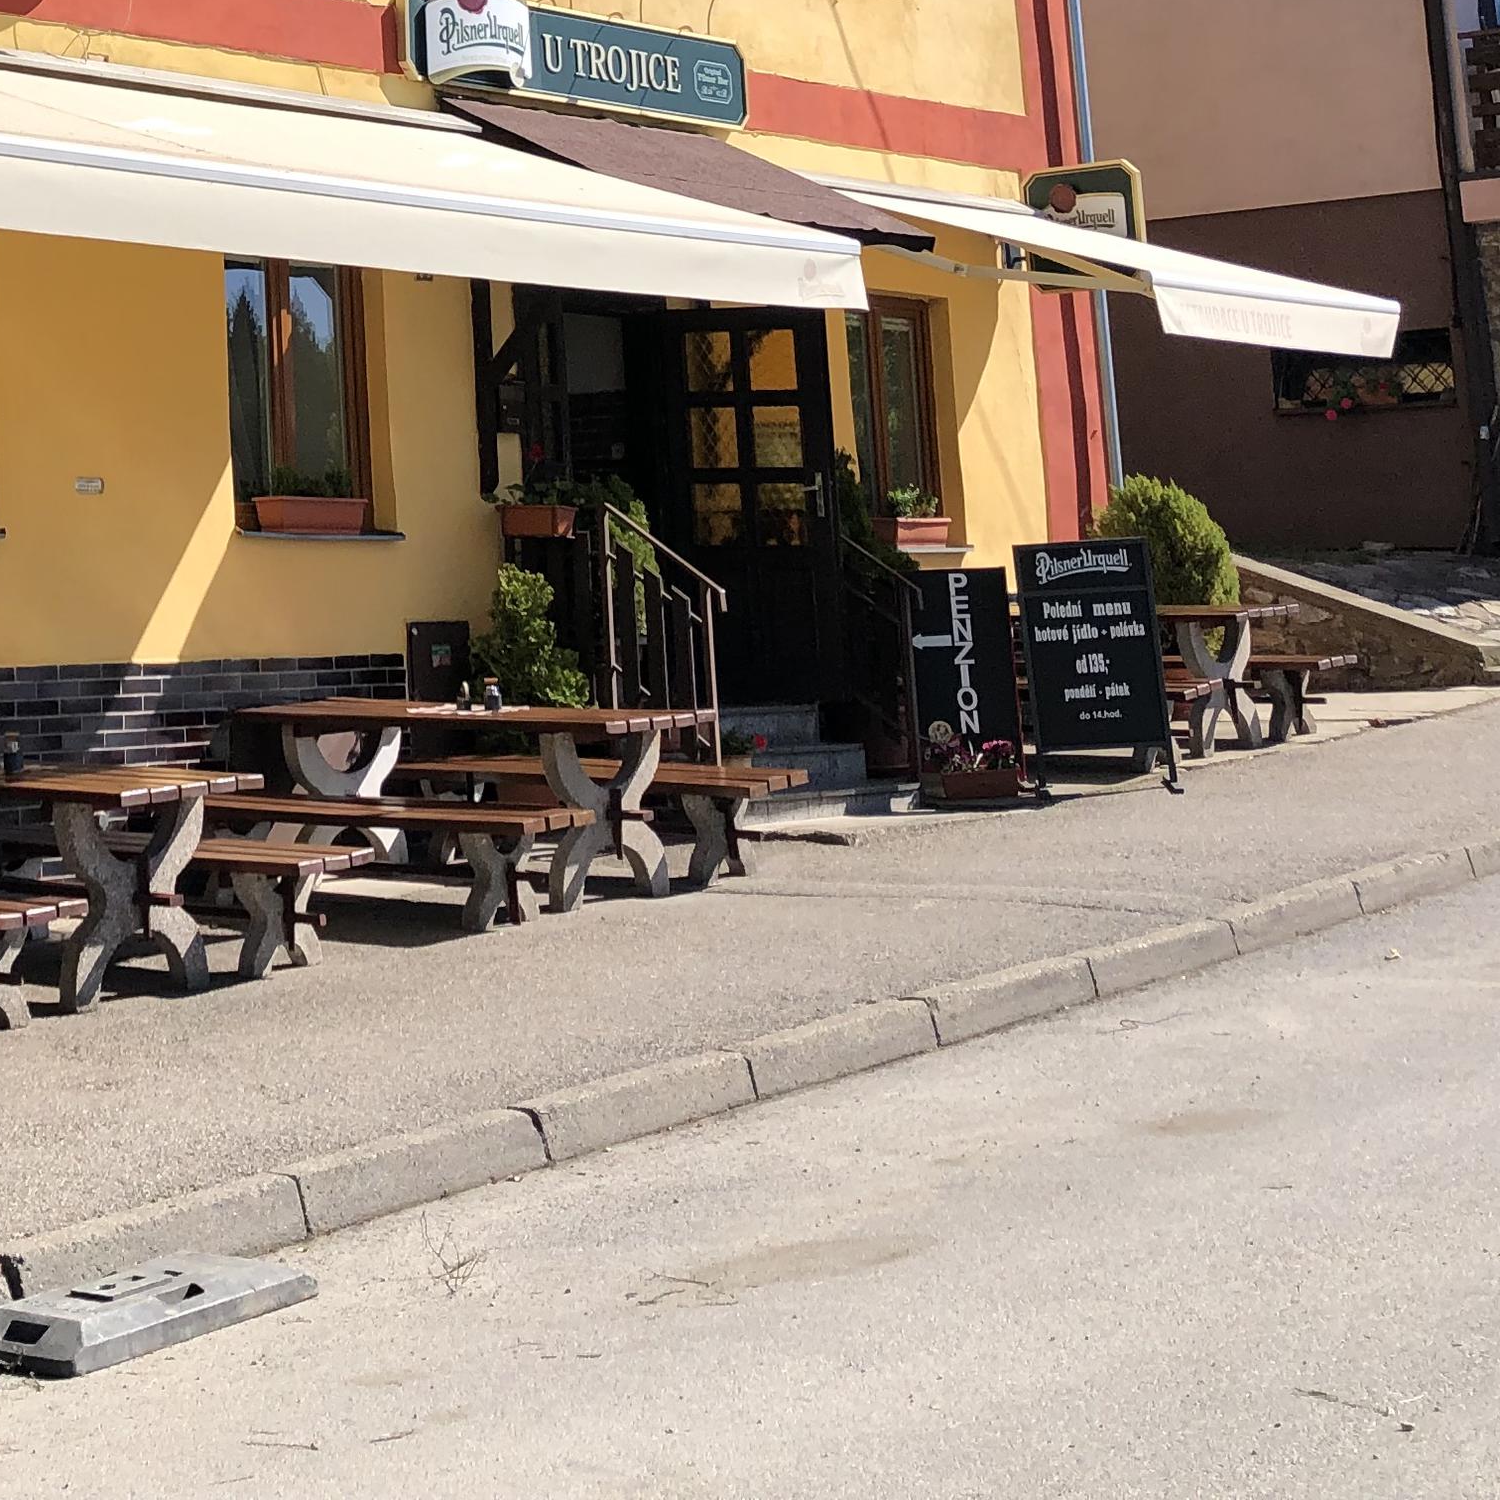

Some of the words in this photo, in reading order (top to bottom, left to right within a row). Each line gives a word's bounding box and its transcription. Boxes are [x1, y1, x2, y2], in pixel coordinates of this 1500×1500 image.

[439, 7, 489, 56] Pilsner
[486, 10, 524, 55] Urquell
[543, 33, 563, 74] U
[570, 38, 682, 93] TROJICE
[1076, 208, 1115, 230] Urquell
[1035, 551, 1082, 585] Pilsner
[1080, 548, 1129, 574] Urquell
[1042, 600, 1083, 619] Polední
[1092, 601, 1132, 617] menu
[1034, 624, 1069, 642] hotové
[1072, 622, 1099, 644] jídlo
[1109, 620, 1146, 639] polévka
[948, 573, 980, 734] PENZION
[1075, 654, 1088, 674] od
[1064, 684, 1097, 702] pondělí
[1104, 682, 1131, 700] pátek
[1079, 711, 1091, 720] do
